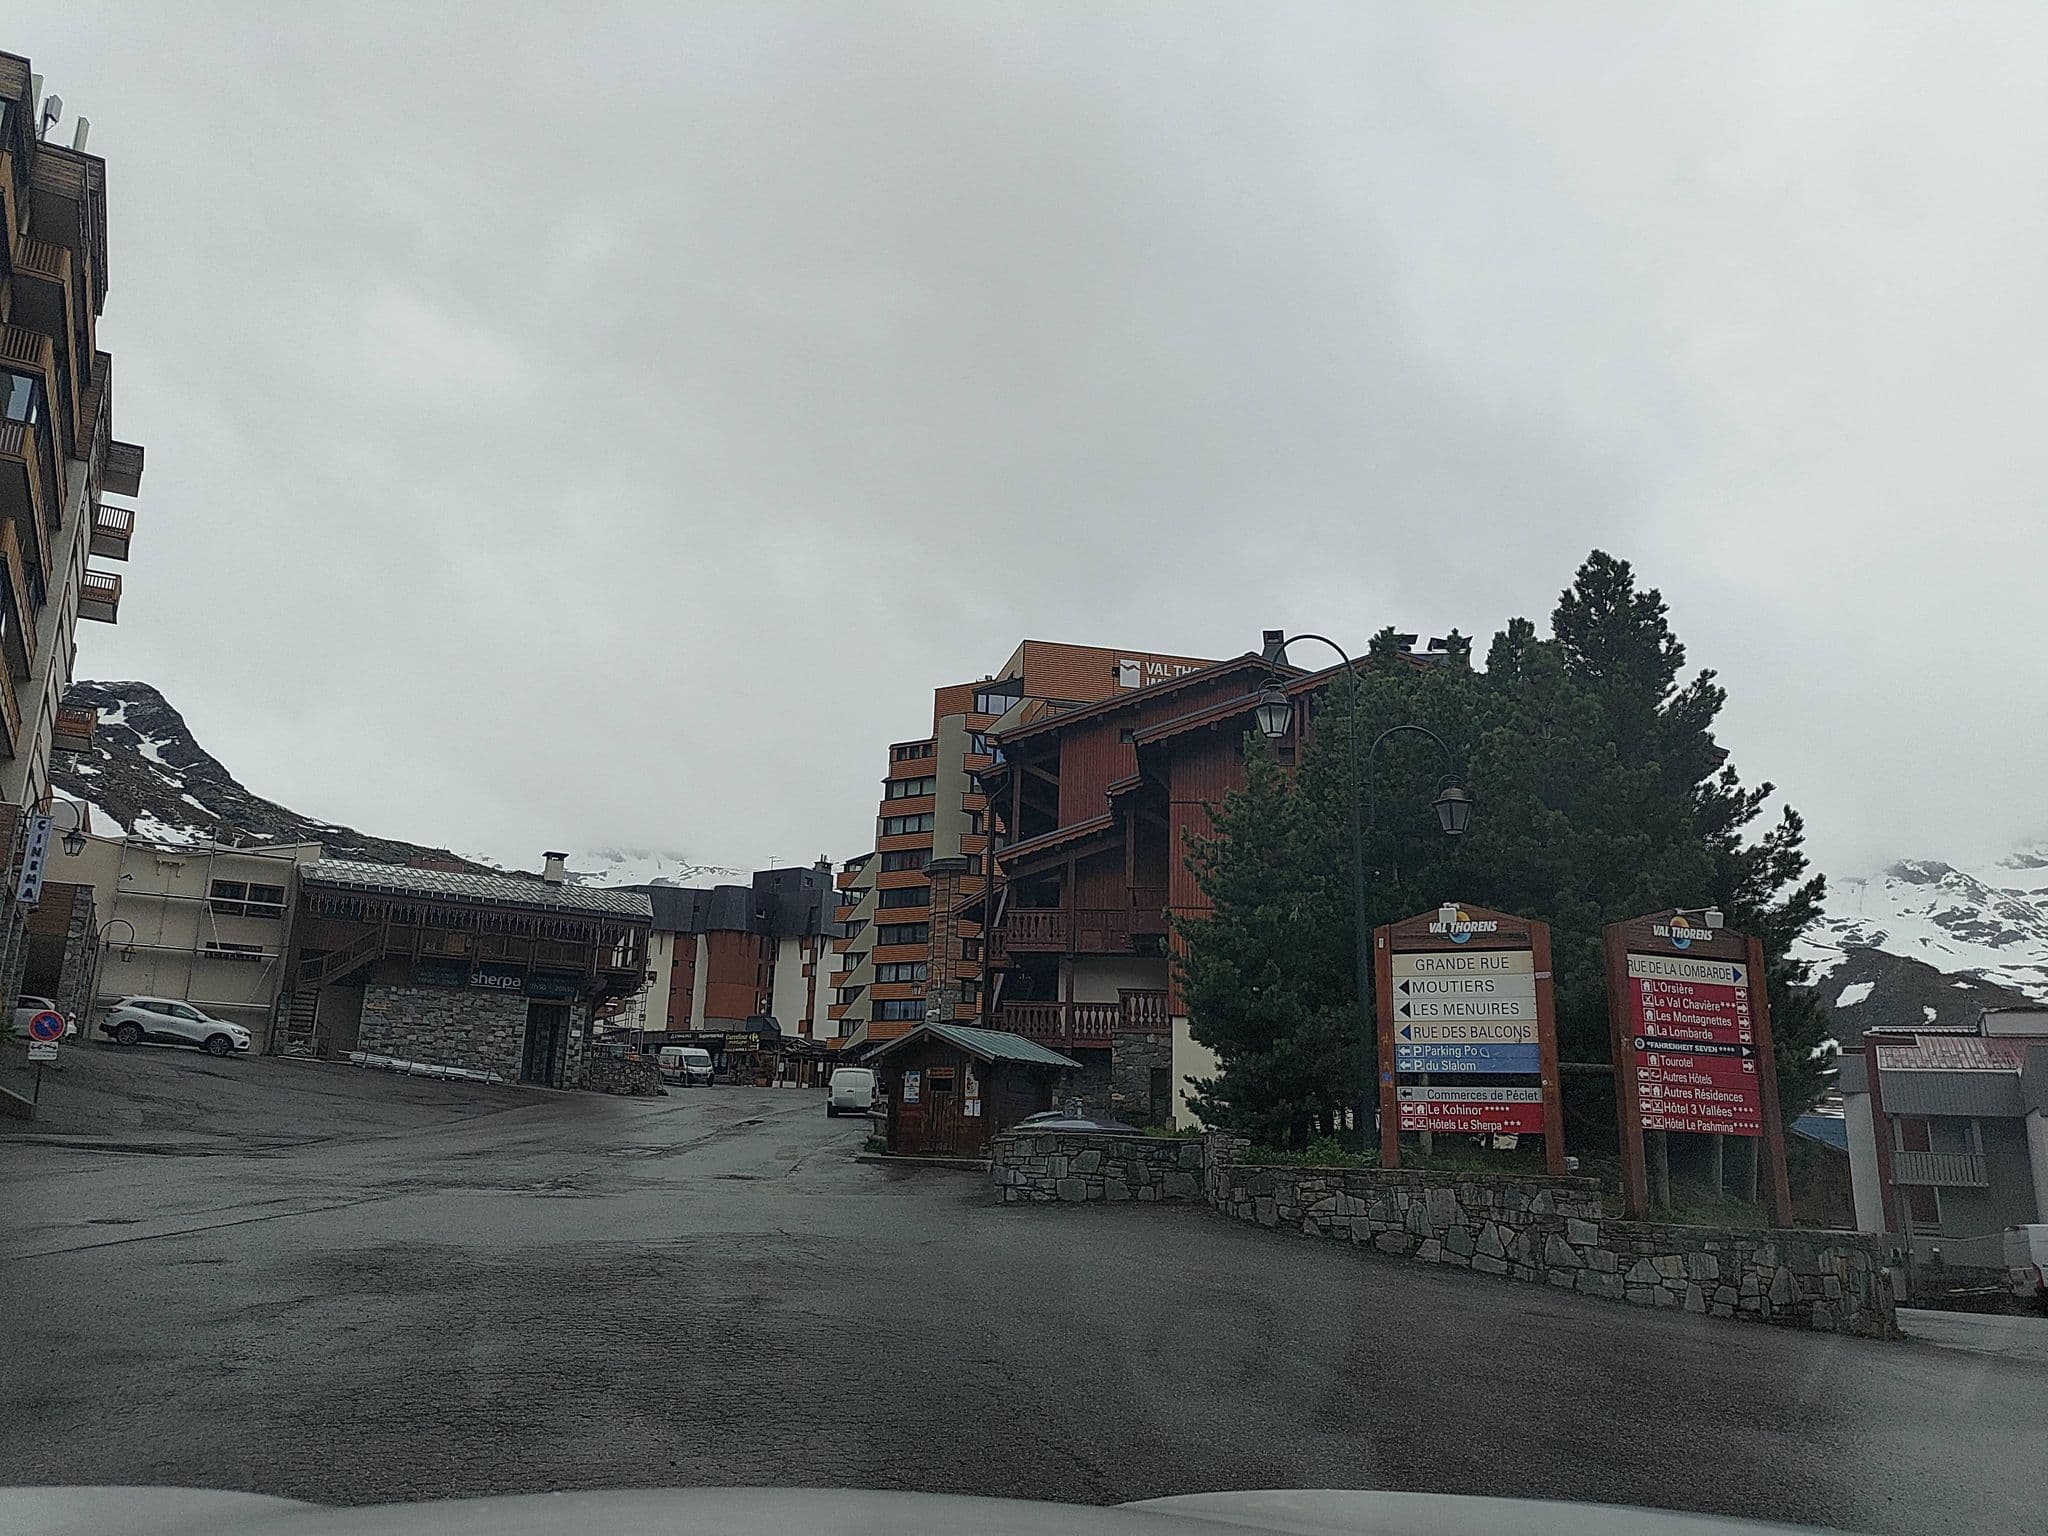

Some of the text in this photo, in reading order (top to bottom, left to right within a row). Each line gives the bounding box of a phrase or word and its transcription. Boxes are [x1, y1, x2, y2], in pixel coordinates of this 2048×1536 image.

[1146, 662, 1171, 676] VAL
[23, 820, 46, 898] CINEMA
[1429, 920, 1498, 934] VAL THORENS
[1653, 925, 1713, 941] VAL THORENS
[1415, 957, 1510, 971] GRANDE RUE
[1627, 960, 1732, 980] RUE DE LA LOMBARDE
[470, 970, 521, 988] sherpa
[1412, 980, 1495, 993] MOUTIERS
[1653, 981, 1694, 995] L'Orsière
[1413, 1002, 1520, 1016] LES MENUIRES
[1654, 996, 1721, 1012] Le Val Chavière
[1656, 1010, 1732, 1027] Les Montagnettes
[1414, 1025, 1531, 1038] RUE DES BALCONS
[1657, 1025, 1713, 1040] La Lombarde
[1424, 1045, 1461, 1058] Parking
[1695, 1045, 1718, 1053] SEVEN
[1426, 1060, 1439, 1071] du
[1441, 1060, 1477, 1071] Slalom
[1660, 1055, 1694, 1068] Tourotel
[1663, 1071, 1713, 1085] Autres Hôtels
[1427, 1089, 1539, 1101] Commerces de Péclet
[1664, 1087, 1744, 1103] Autres Résidences
[1428, 1103, 1483, 1116] Le Kohinor
[1664, 1102, 1733, 1117] Hôtel 3 Vallées
[1429, 1119, 1502, 1132] Hôtels Le Sherpa
[1664, 1118, 1734, 1133] Hôtel Le Pashmina
